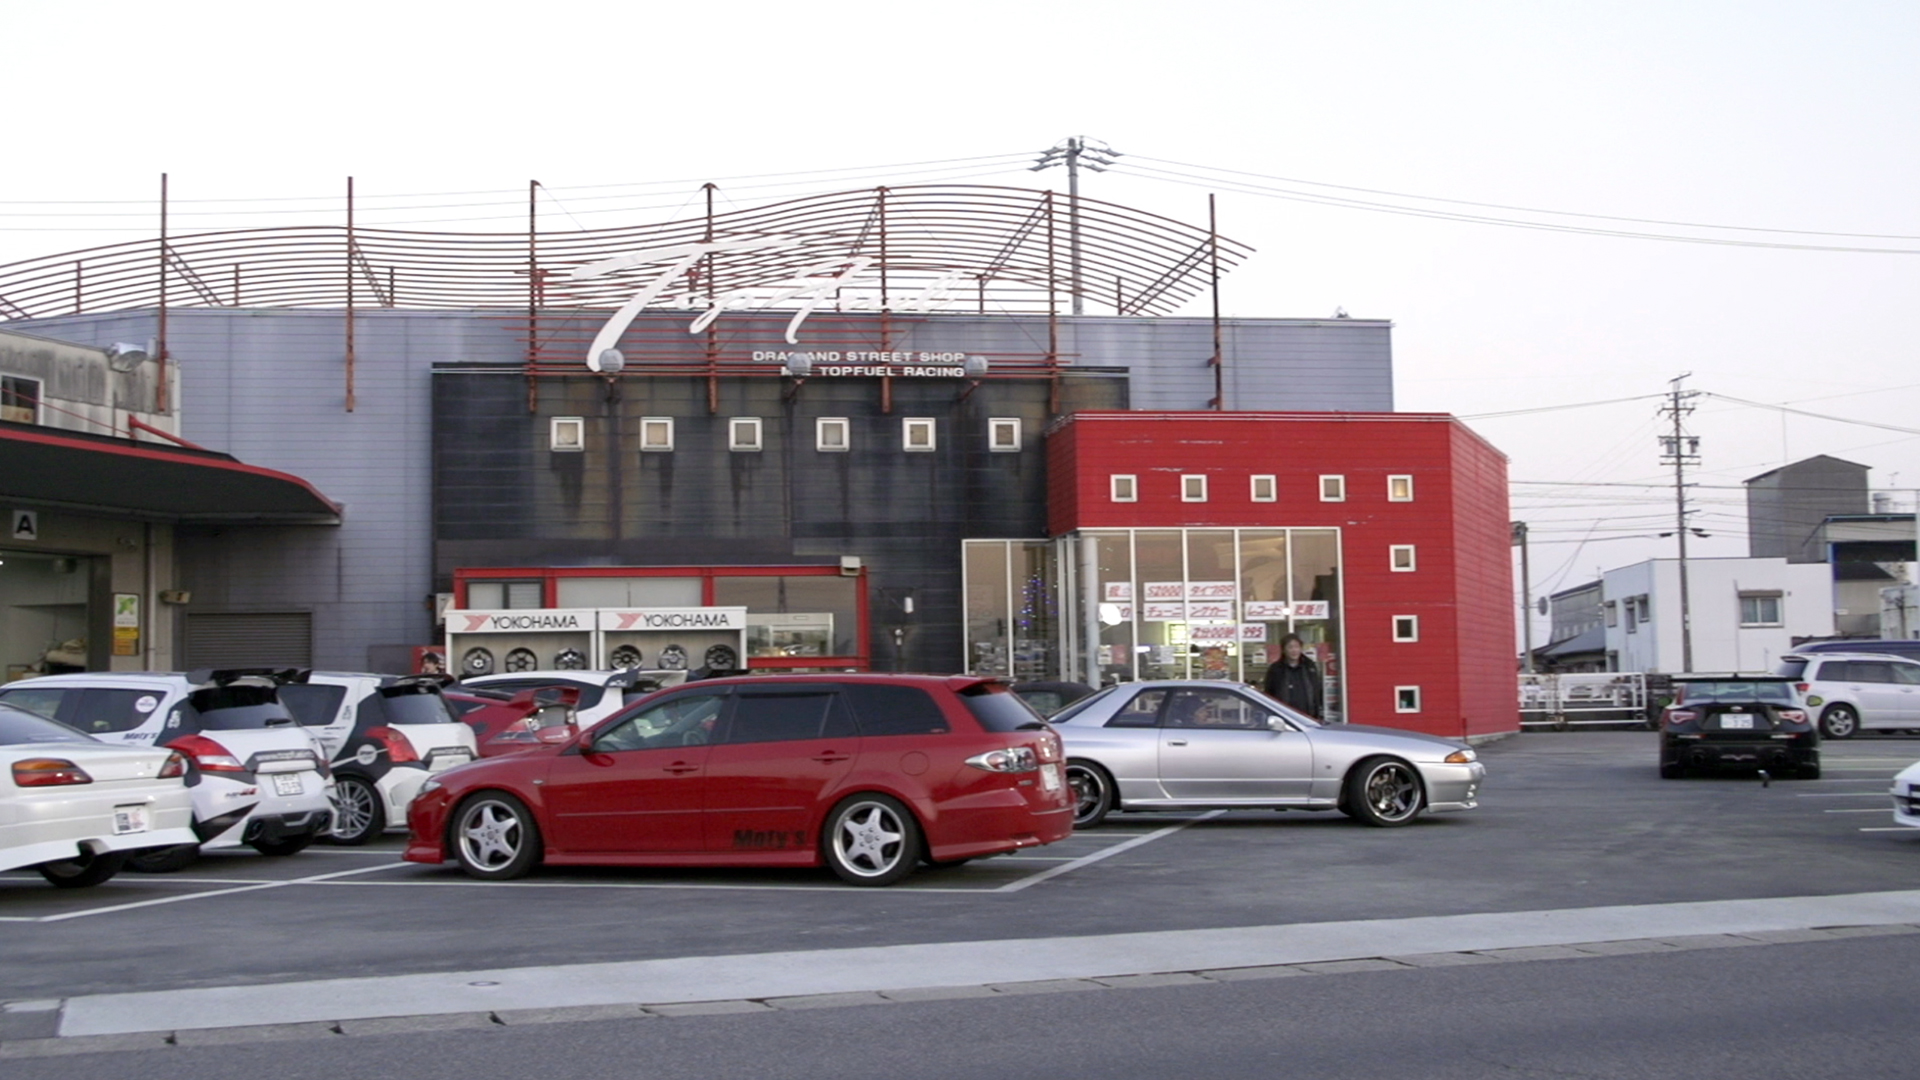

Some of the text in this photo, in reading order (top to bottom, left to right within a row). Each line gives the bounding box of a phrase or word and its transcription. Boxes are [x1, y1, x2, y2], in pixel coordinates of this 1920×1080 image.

[846, 351, 912, 362] STREET
[919, 352, 965, 363] SHOP
[819, 366, 896, 377] TOPFUEL
[903, 366, 965, 378] RACING
[16, 514, 35, 535] A
[491, 615, 579, 629] YOKOHAMA
[644, 613, 730, 628] YOKOHAMA
